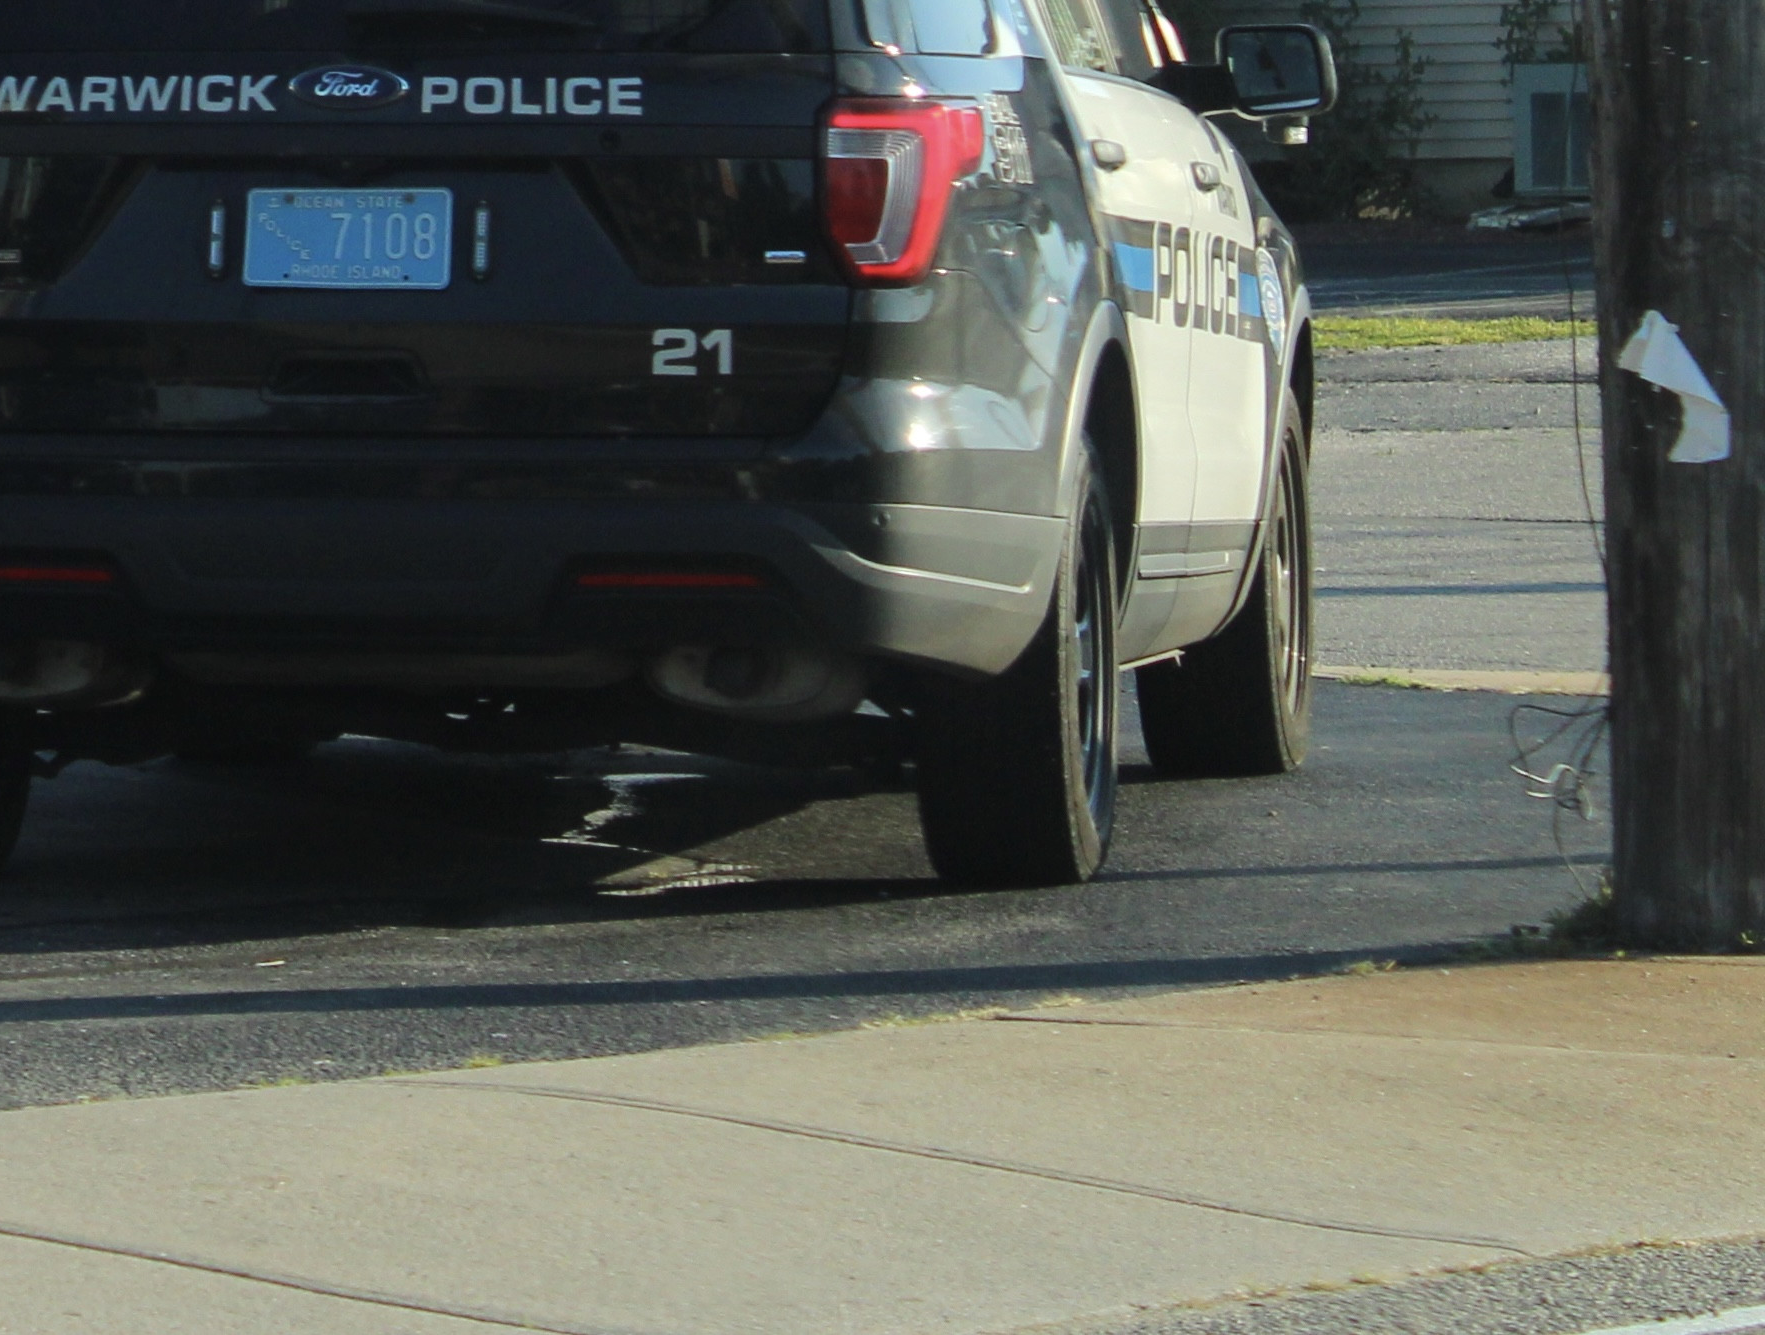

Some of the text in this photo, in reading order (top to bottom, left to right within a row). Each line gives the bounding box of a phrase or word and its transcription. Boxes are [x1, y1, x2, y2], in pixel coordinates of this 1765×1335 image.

[314, 70, 380, 97] Ford
[421, 76, 643, 115] POLICE
[294, 195, 404, 209] OCEAN STATE
[258, 212, 311, 261] POLICE
[330, 212, 437, 261] 7108
[290, 263, 402, 280] RHODE ISLAND
[1155, 220, 1237, 338] POLICE
[652, 328, 733, 376] 21
